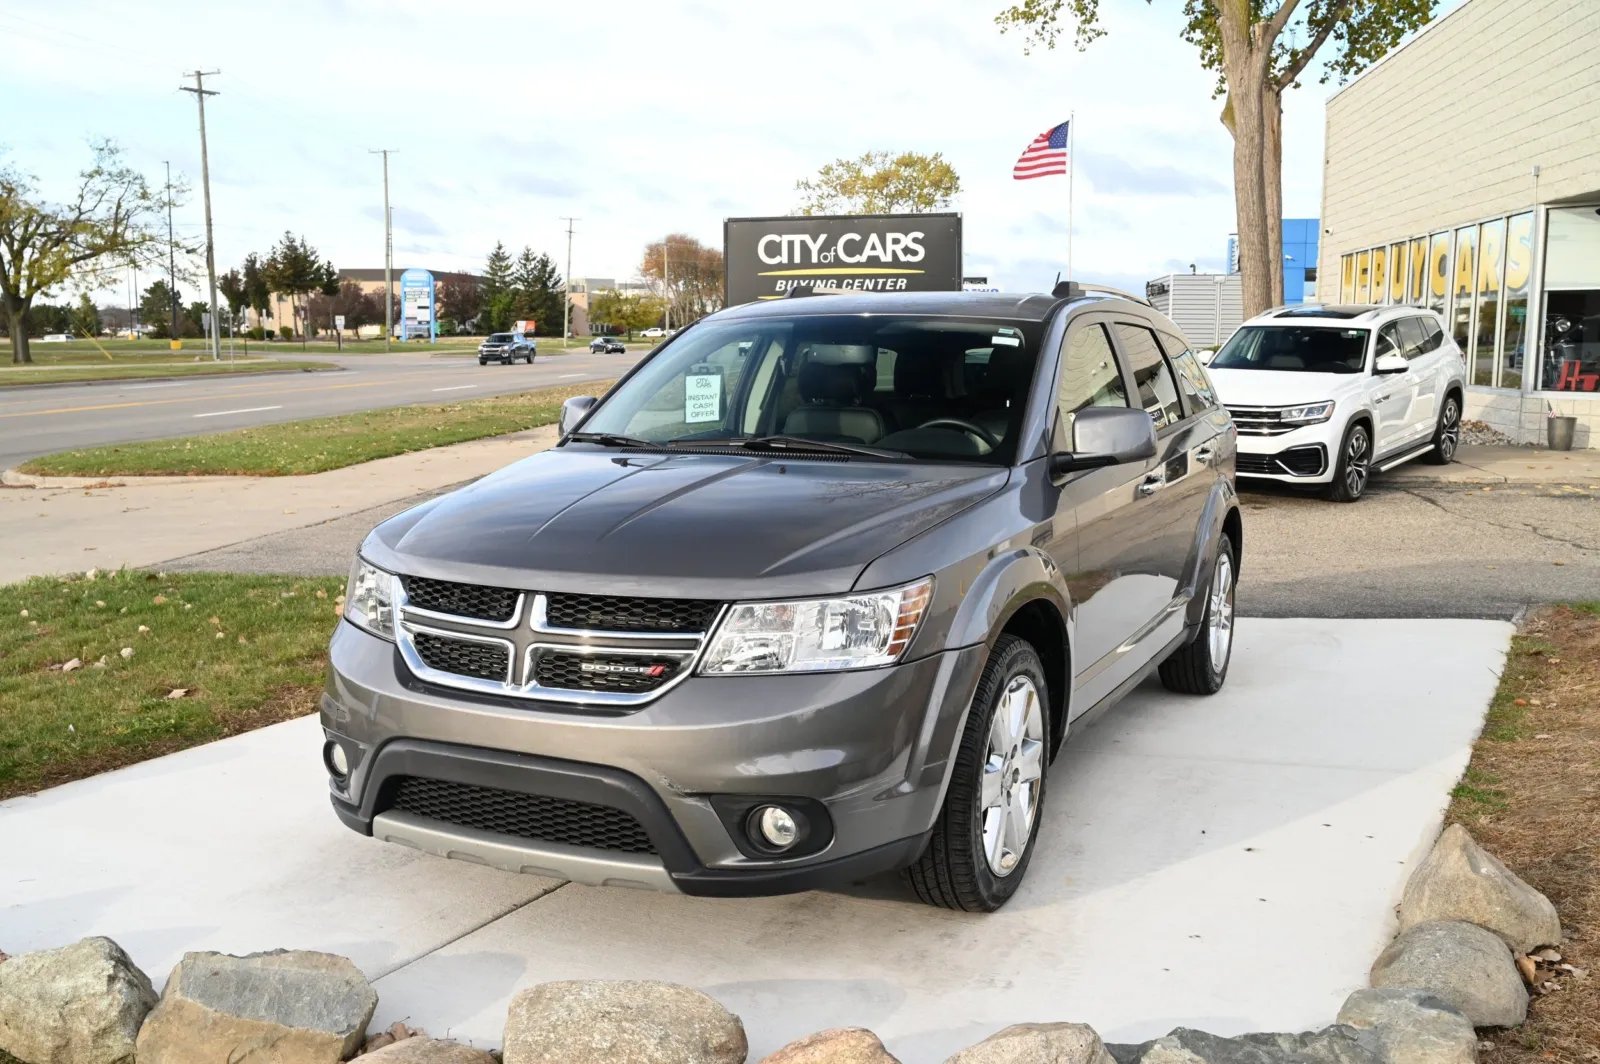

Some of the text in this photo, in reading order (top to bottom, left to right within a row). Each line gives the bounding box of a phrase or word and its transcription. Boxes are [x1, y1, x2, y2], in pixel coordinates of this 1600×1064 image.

[757, 231, 925, 264] CITY of CARS
[1371, 239, 1427, 304] BUY
[1431, 218, 1532, 297] CARS
[842, 278, 907, 292] CENTER
[687, 393, 718, 401] INSTANT
[690, 410, 715, 418] OFFER
[581, 662, 652, 673] DODGE
